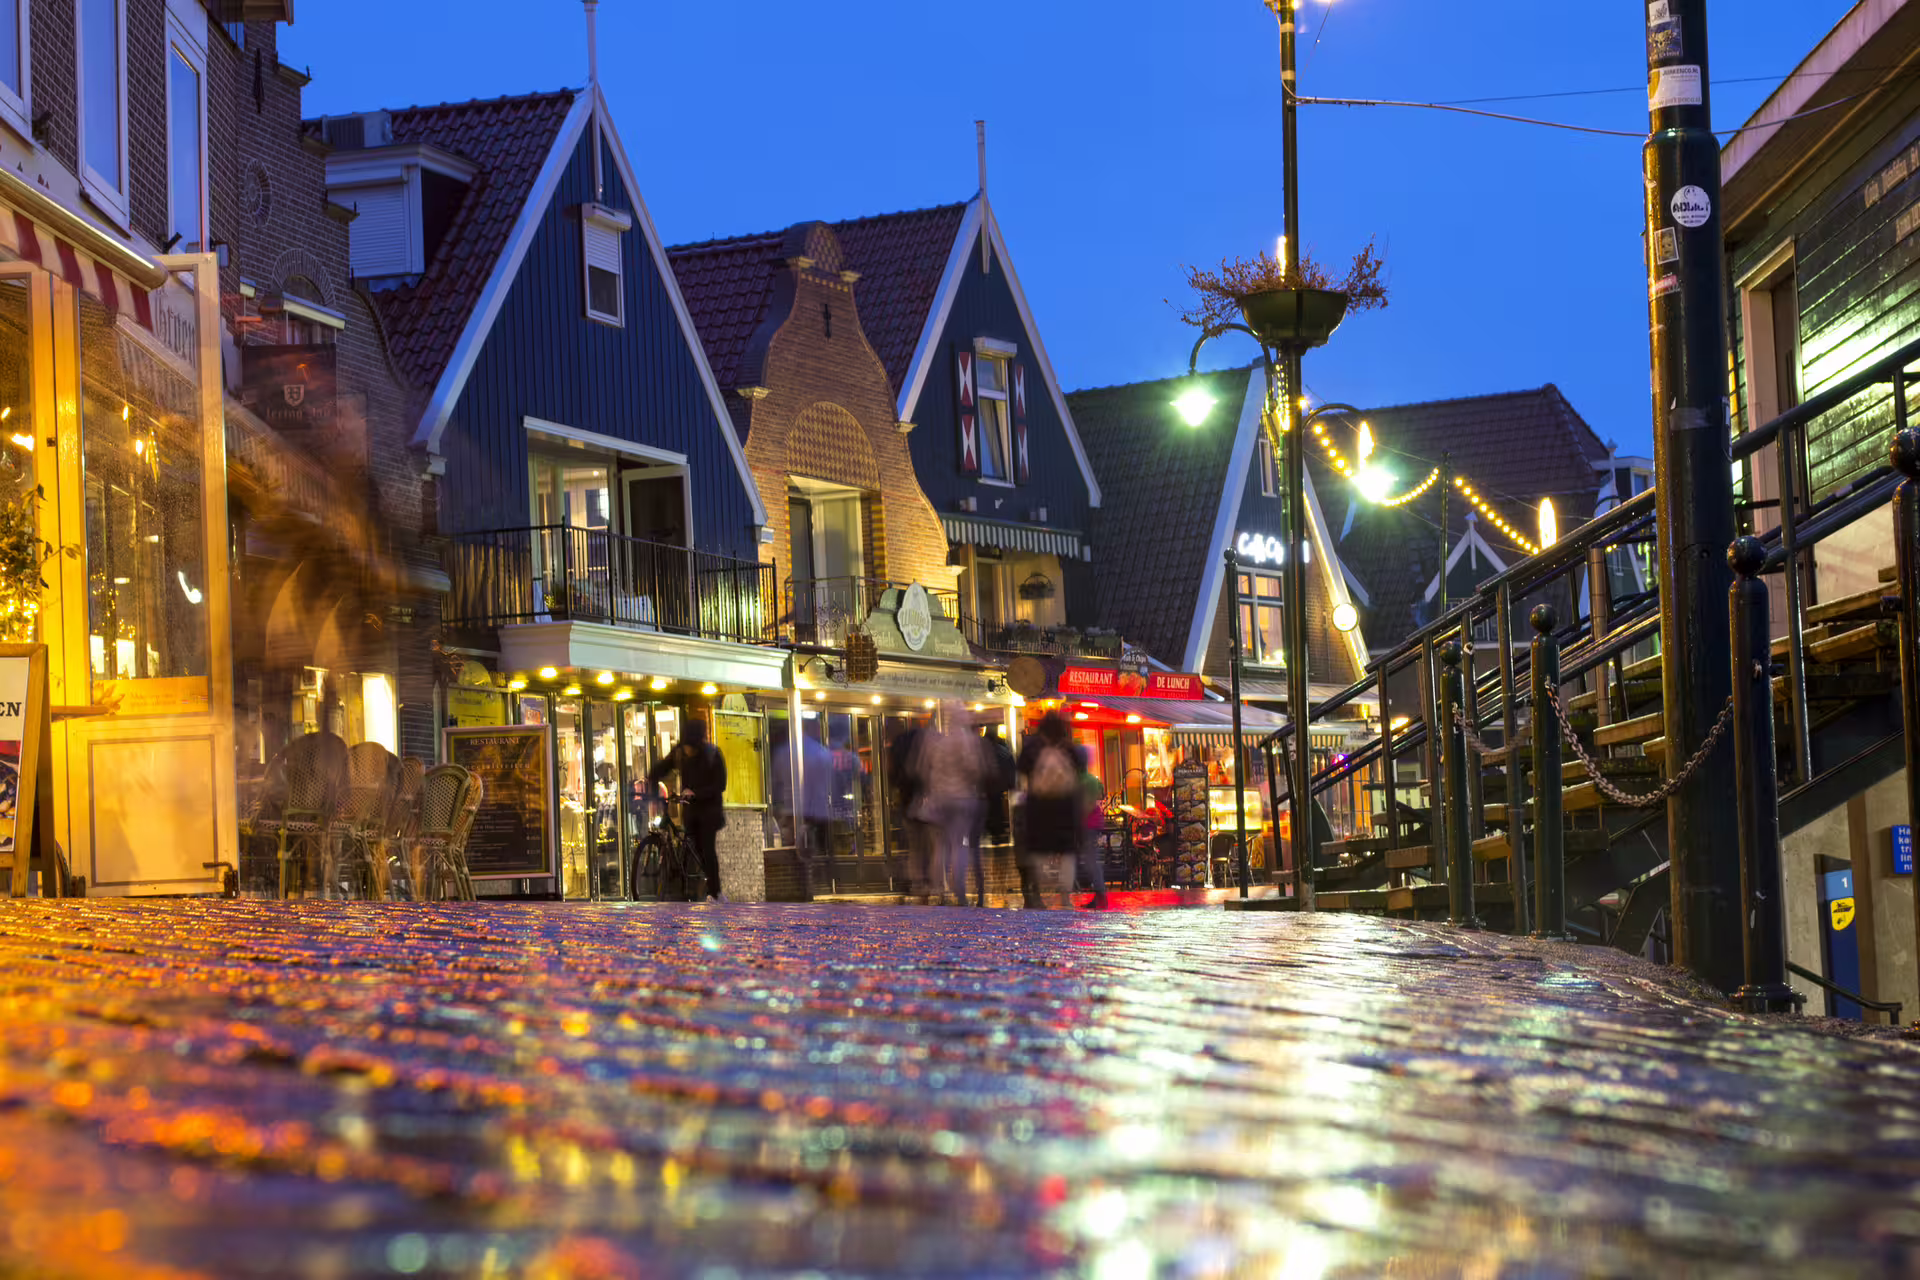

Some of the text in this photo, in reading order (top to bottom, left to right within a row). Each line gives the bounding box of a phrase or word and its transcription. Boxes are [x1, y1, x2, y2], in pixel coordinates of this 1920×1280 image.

[1069, 671, 1113, 685] RESTAURANT
[1156, 676, 1190, 689] DE LUNCH
[470, 737, 520, 746] RESTAURANT
[1898, 837, 1912, 845] ka
[1841, 877, 1848, 888] 1
